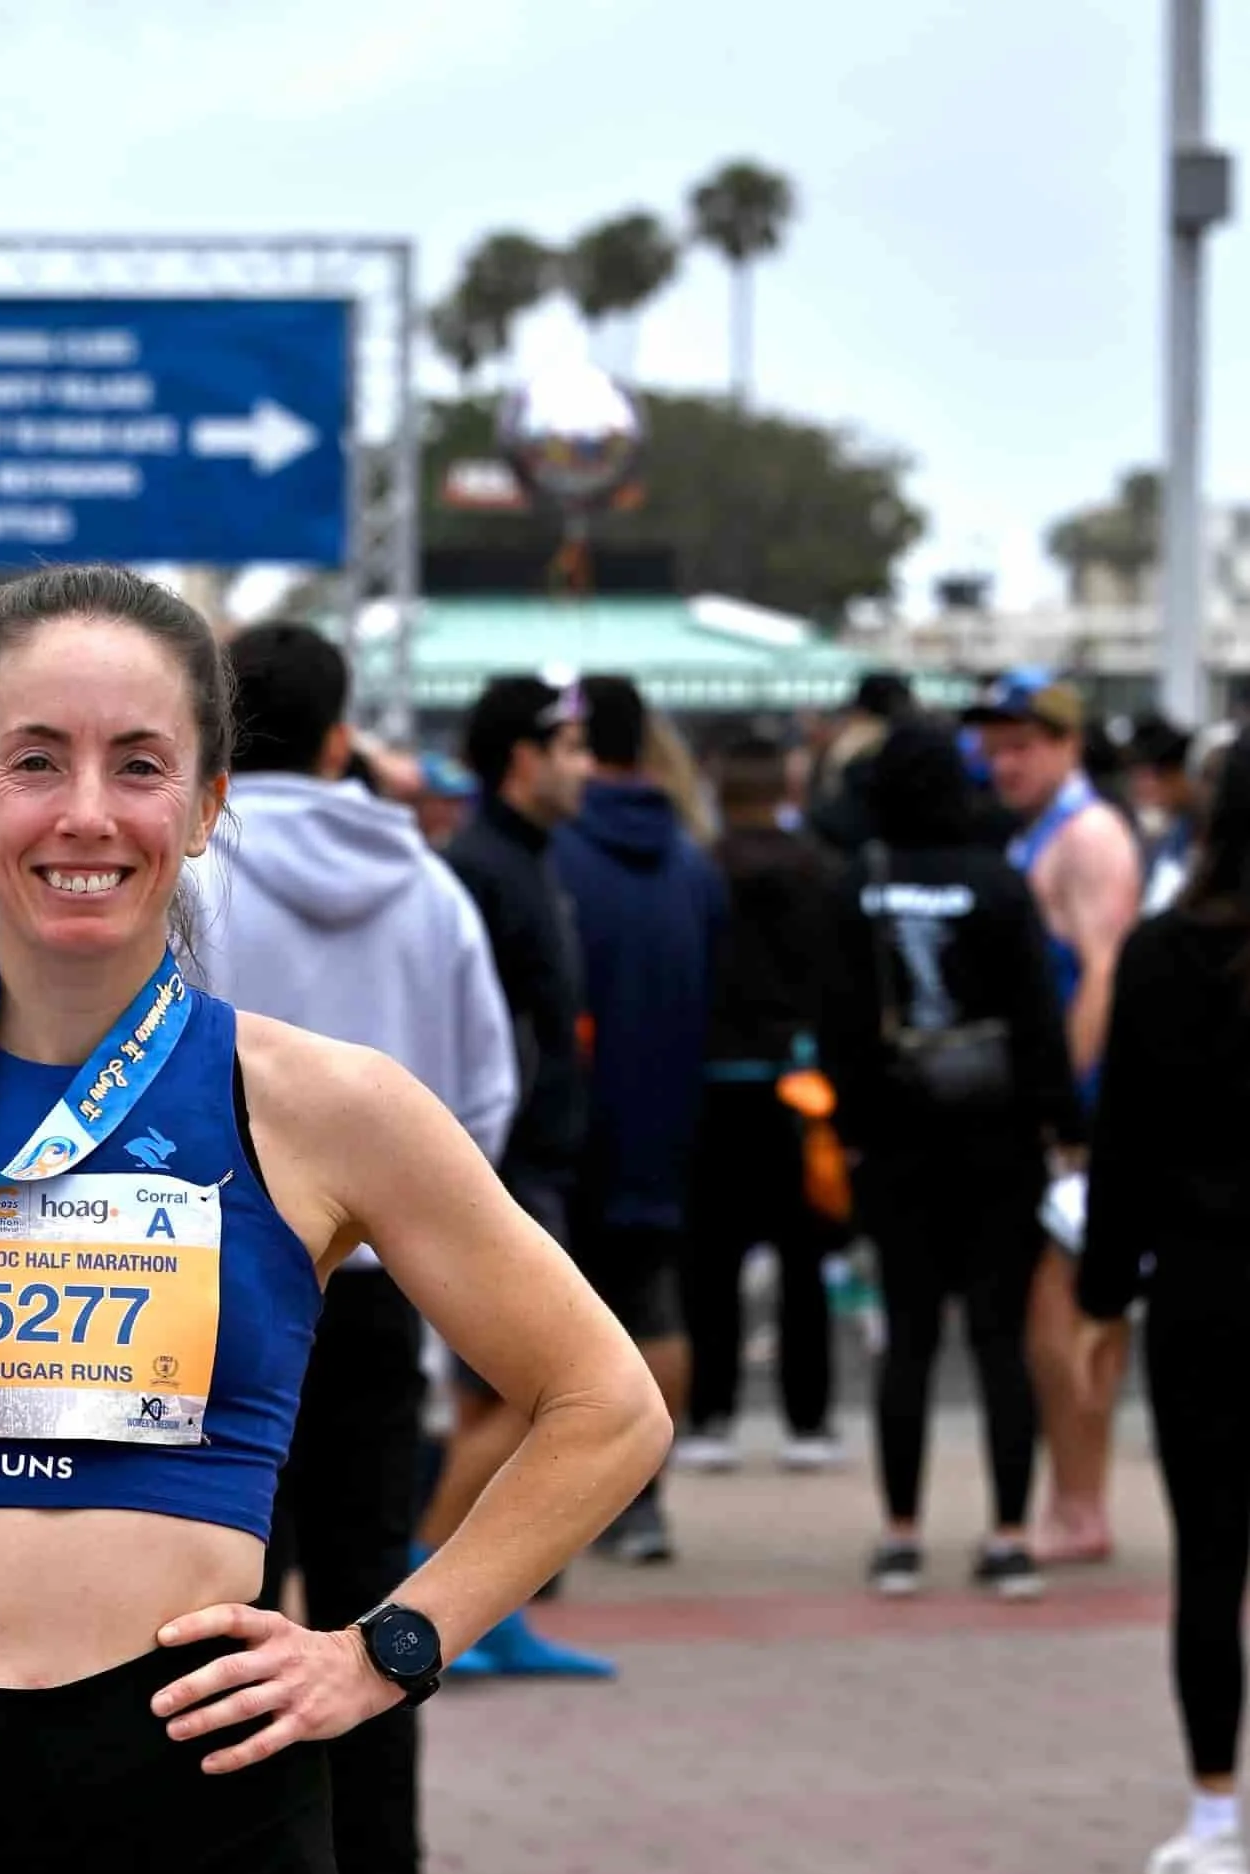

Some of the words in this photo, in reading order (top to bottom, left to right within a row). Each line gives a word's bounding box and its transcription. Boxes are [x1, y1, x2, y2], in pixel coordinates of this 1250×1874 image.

[136, 1188, 188, 1205] Corral
[145, 1207, 176, 1239] A
[25, 1251, 71, 1271] HALF
[76, 1252, 178, 1273] MARATHON
[70, 1363, 134, 1383] RUNS
